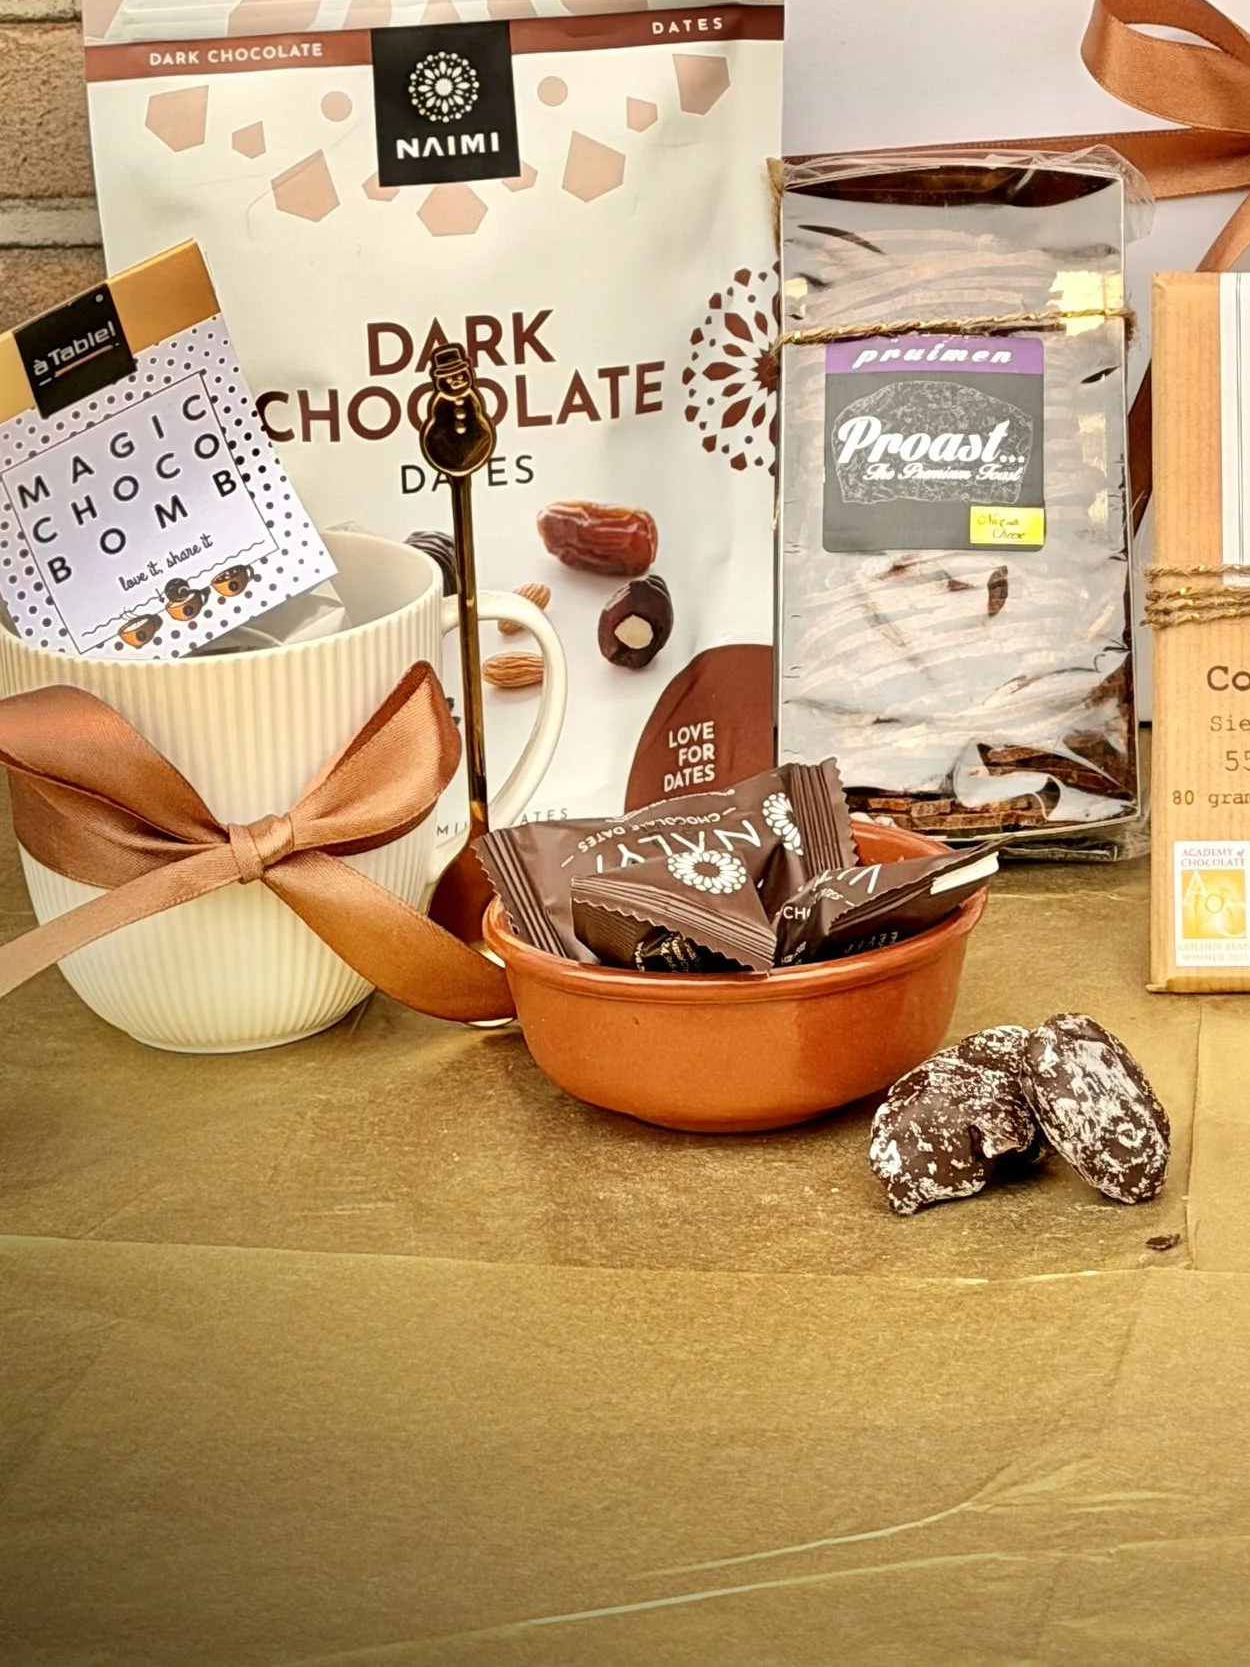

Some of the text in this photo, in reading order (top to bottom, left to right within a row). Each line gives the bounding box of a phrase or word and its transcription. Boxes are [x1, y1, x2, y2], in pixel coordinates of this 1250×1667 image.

[652, 16, 724, 34] DATES
[149, 42, 323, 67] DARK CHOCOLATE
[396, 132, 500, 160] NAIMI
[47, 320, 116, 366] Table!
[366, 309, 556, 376] DARK
[852, 343, 1012, 369] pruimen
[401, 454, 534, 494] DES
[863, 462, 1024, 482] The Premium Toast
[118, 572, 149, 592] love
[166, 546, 202, 568] share
[201, 534, 214, 549] it
[668, 721, 715, 748] LOVE
[678, 743, 715, 766] FOR
[664, 764, 715, 792] DATES
[1172, 790, 1194, 805] 80
[577, 826, 626, 853] DATES
[1182, 848, 1233, 857] ACADEMY
[1181, 858, 1246, 867] CHOCOLATE
